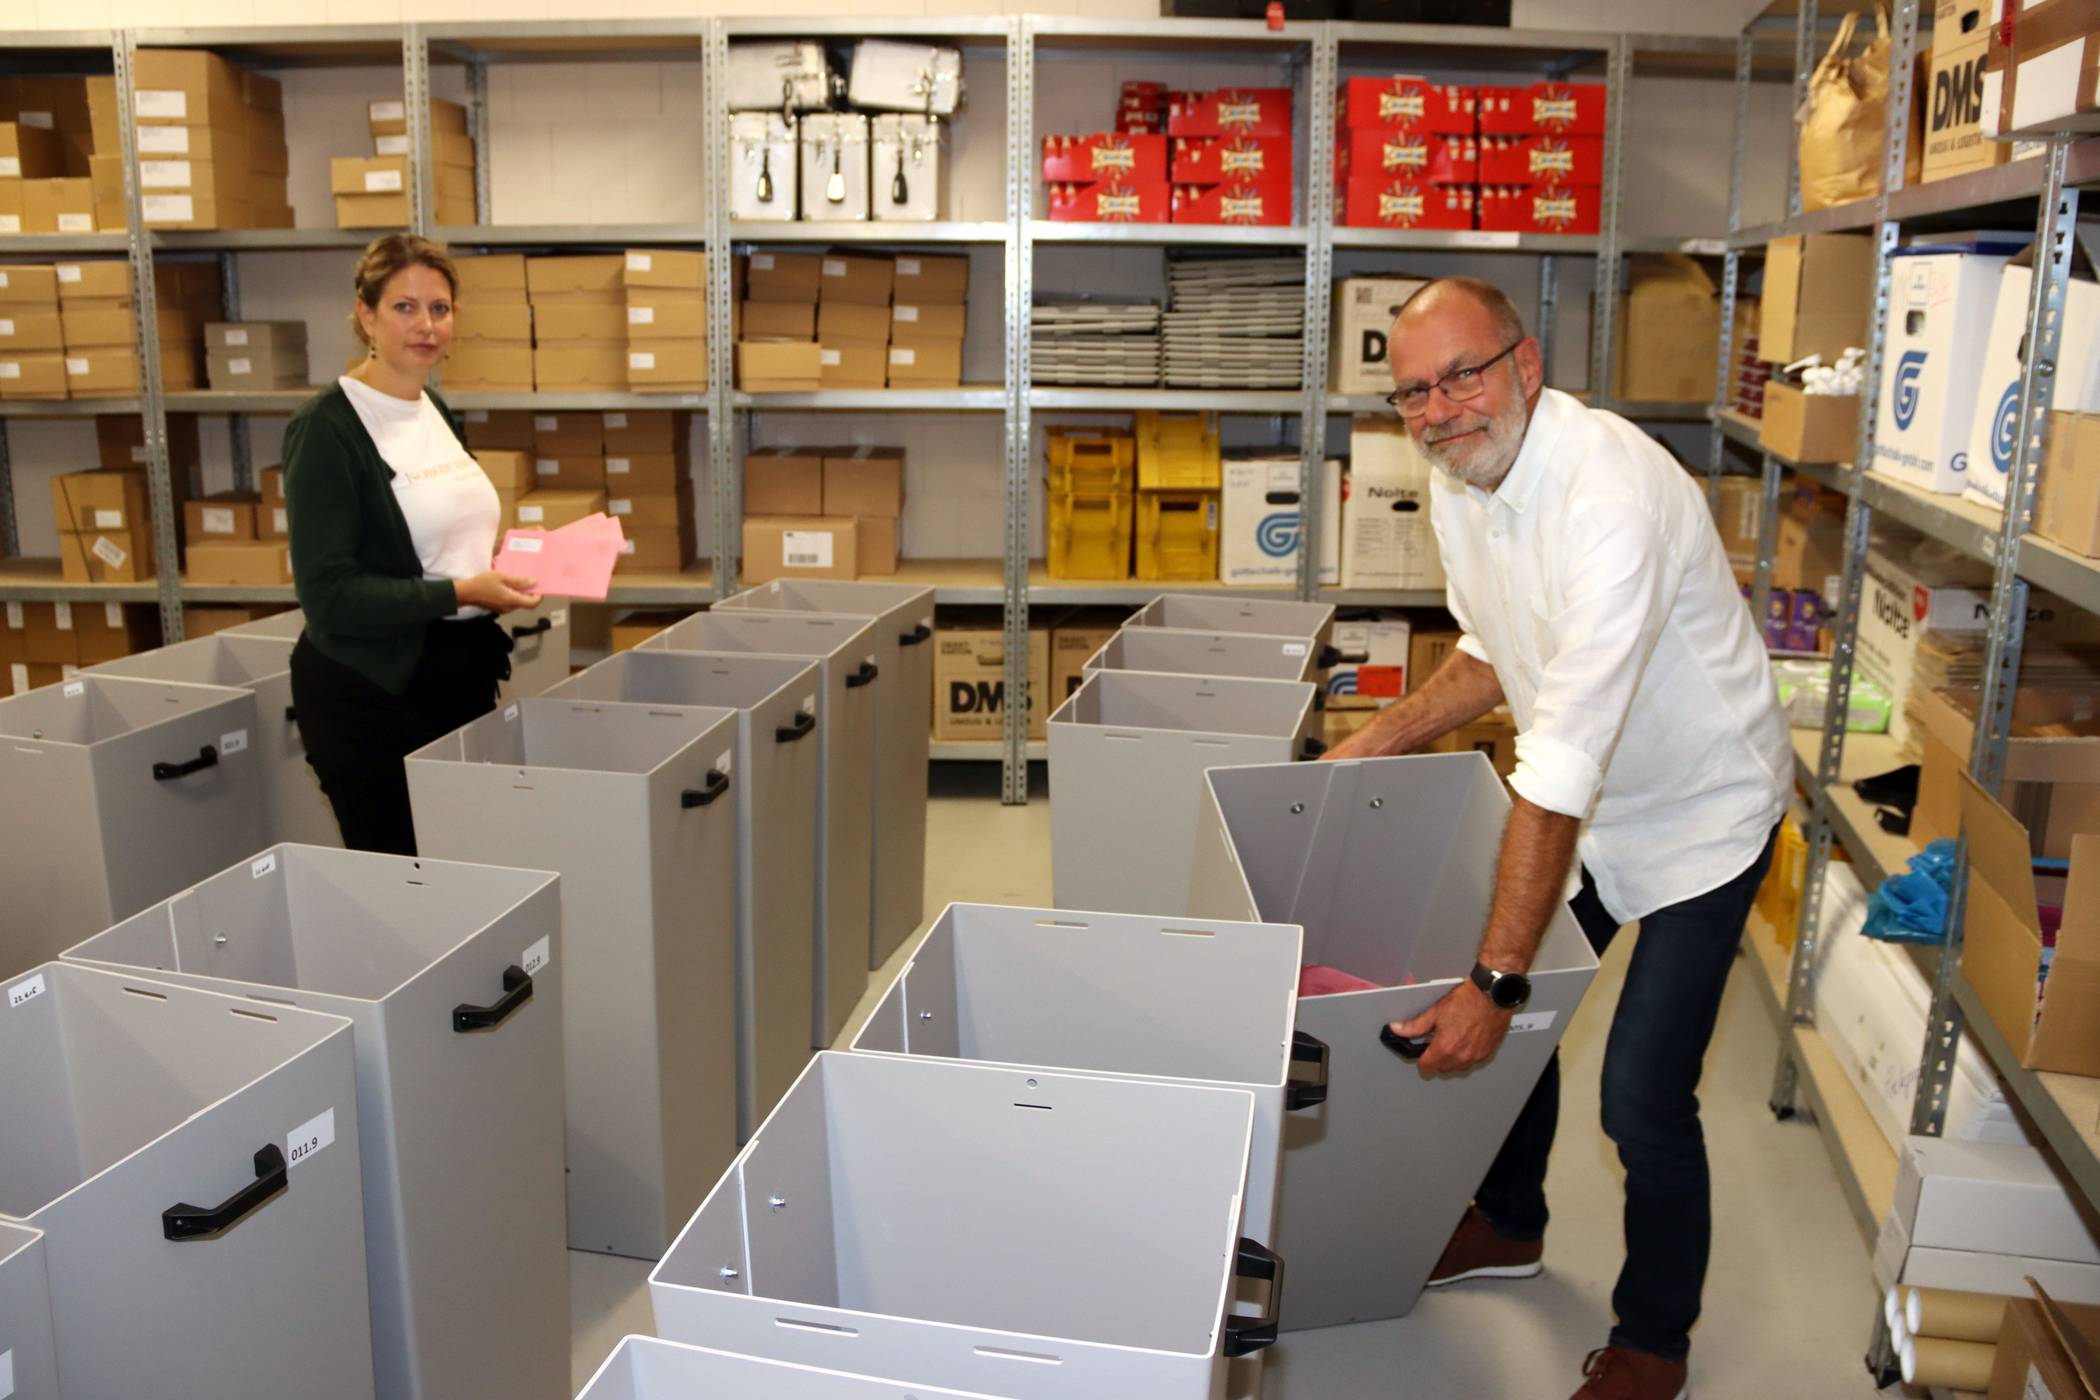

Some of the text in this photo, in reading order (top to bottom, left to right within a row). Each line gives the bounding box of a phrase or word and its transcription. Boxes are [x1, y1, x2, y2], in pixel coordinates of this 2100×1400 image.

[1932, 53, 1988, 132] DMS
[1367, 487, 1419, 498] Nolte
[1875, 589, 1910, 640] Nolte
[950, 681, 1034, 714] DM
[291, 1136, 318, 1161] 011.9
